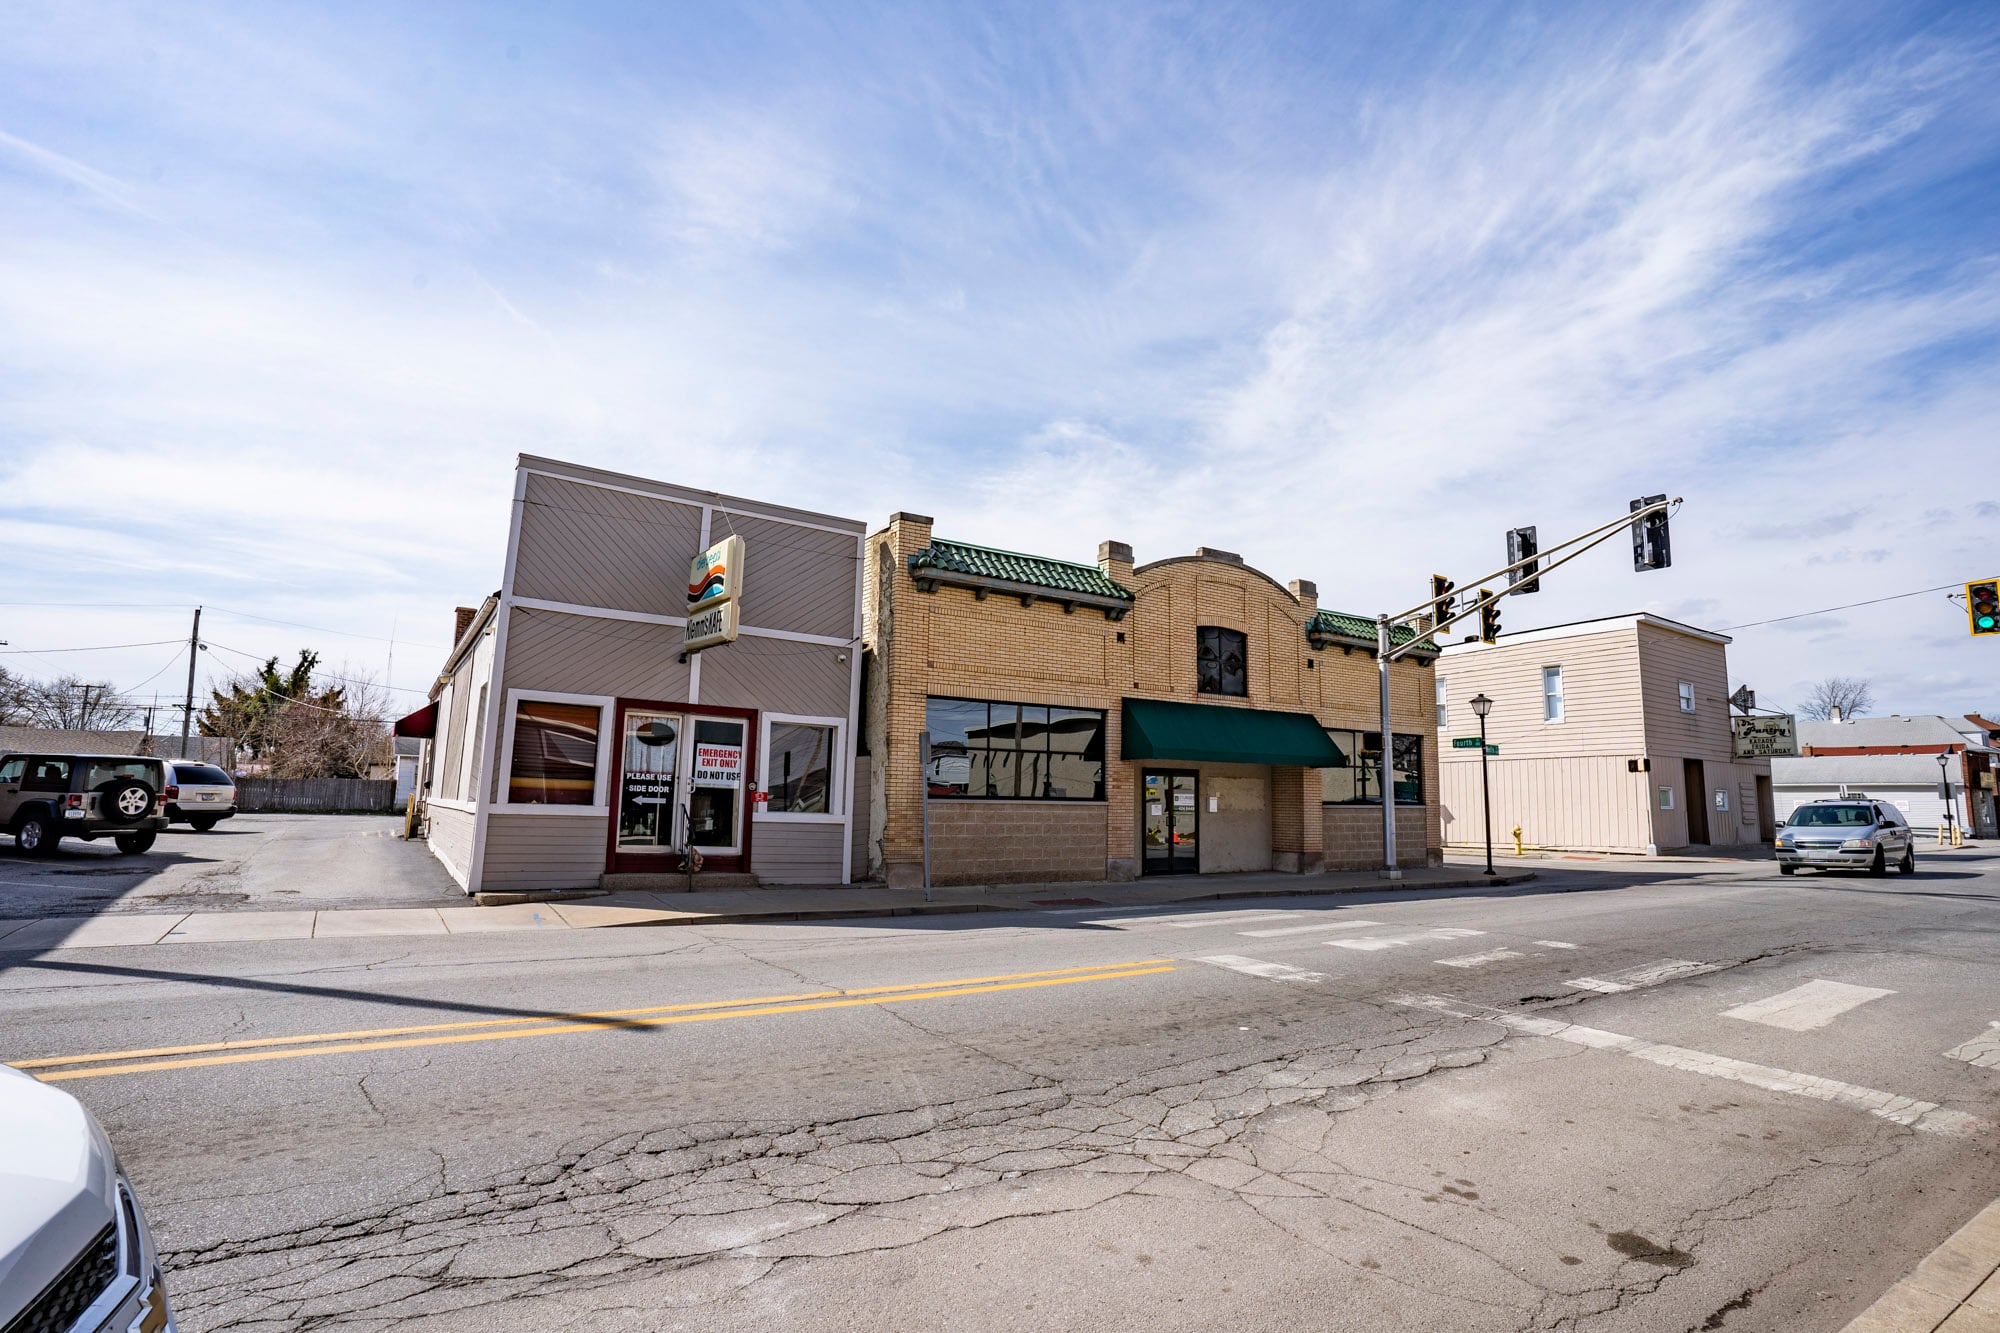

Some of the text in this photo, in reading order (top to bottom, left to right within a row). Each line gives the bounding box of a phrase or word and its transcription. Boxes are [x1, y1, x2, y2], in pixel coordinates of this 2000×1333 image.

[1743, 726, 1787, 737] Pantry
[1453, 739, 1473, 747] Fourth
[698, 748, 742, 759] EMERGENCY
[702, 758, 738, 768] EXIT ONLY
[626, 772, 655, 780] PLEASE
[697, 770, 741, 781] DO NOT USE
[628, 784, 670, 793] SIDE DOOR
